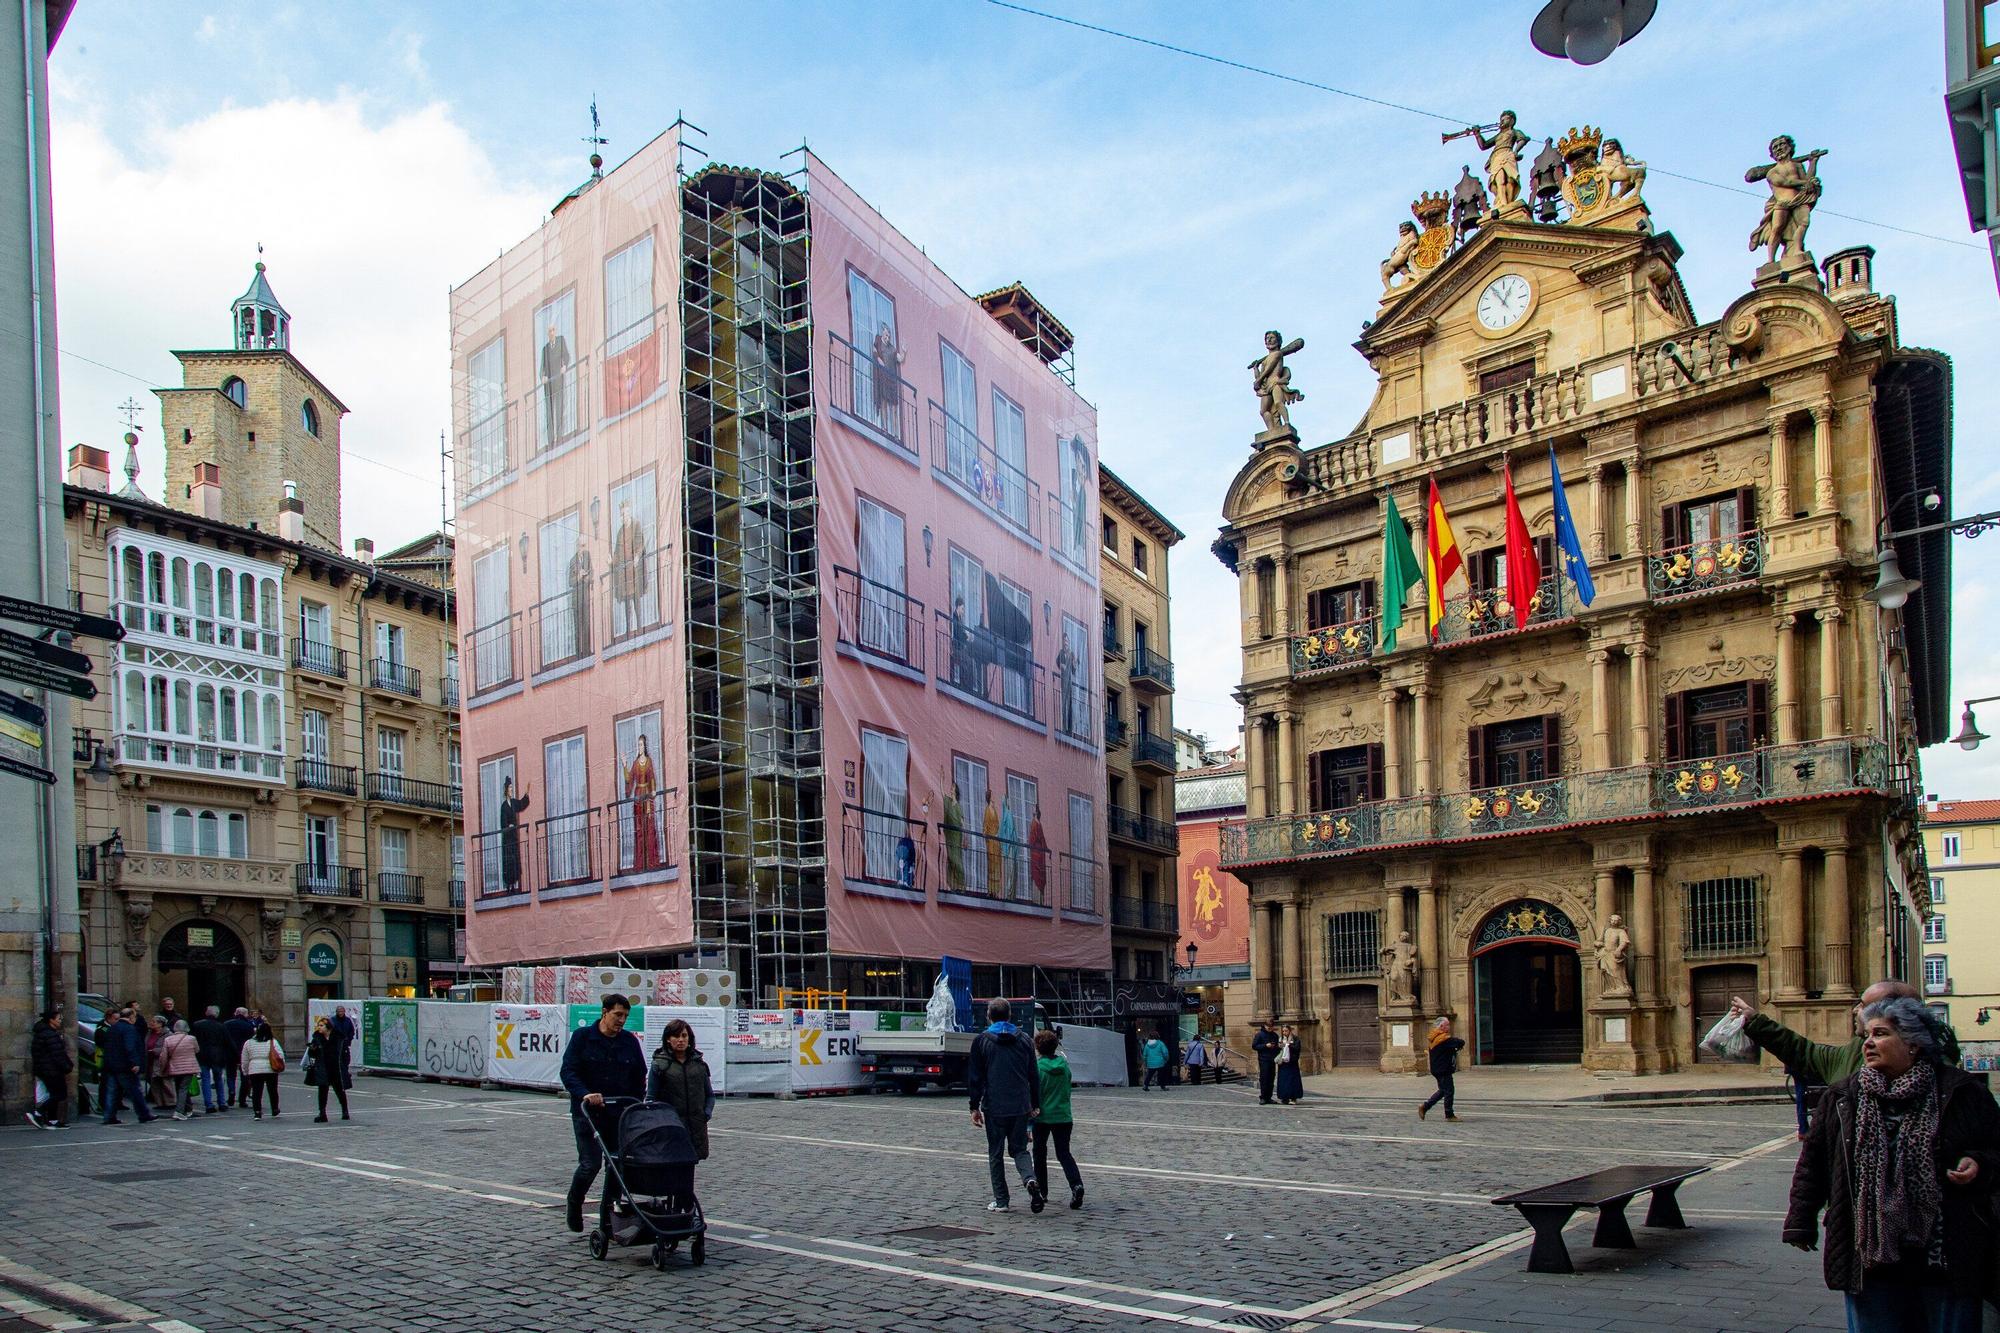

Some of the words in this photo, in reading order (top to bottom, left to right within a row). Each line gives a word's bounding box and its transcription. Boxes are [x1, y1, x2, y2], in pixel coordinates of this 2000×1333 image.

[30, 604, 50, 615] Santo
[51, 610, 81, 622] Domingo
[310, 957, 337, 965] INFANTIL
